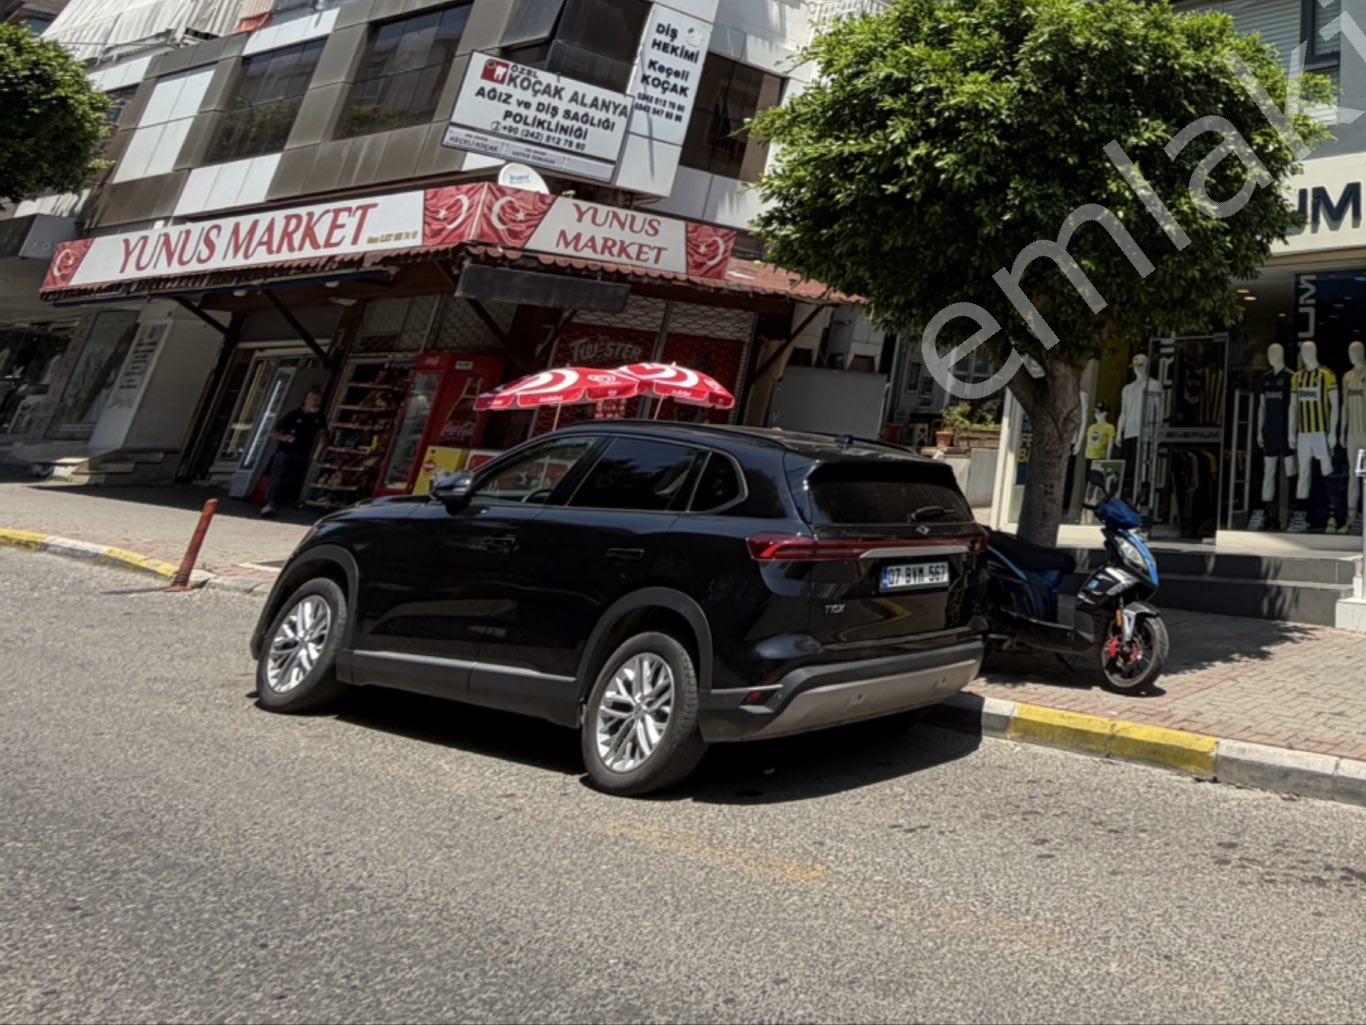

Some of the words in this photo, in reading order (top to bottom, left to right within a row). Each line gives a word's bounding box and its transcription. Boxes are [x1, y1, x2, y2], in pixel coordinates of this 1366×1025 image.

[655, 22, 679, 43] DİŞ
[651, 38, 700, 64] HEKİMİ
[510, 63, 539, 79] ÖZEL
[640, 73, 690, 98] KOÇAK
[648, 58, 690, 82] Keçeli
[474, 85, 513, 105] AĞIZ
[516, 98, 532, 110] ve
[535, 98, 560, 118] DİŞ
[562, 108, 616, 132] SAĞLIĞI
[506, 73, 566, 101] KOÇAK
[568, 90, 630, 119] ALANYA
[502, 109, 589, 141] POLİKLİNİĞİ
[572, 202, 662, 237] YUNUS
[118, 221, 223, 274] YUNUS
[222, 202, 379, 262] MARKET
[555, 228, 669, 266] MARKET
